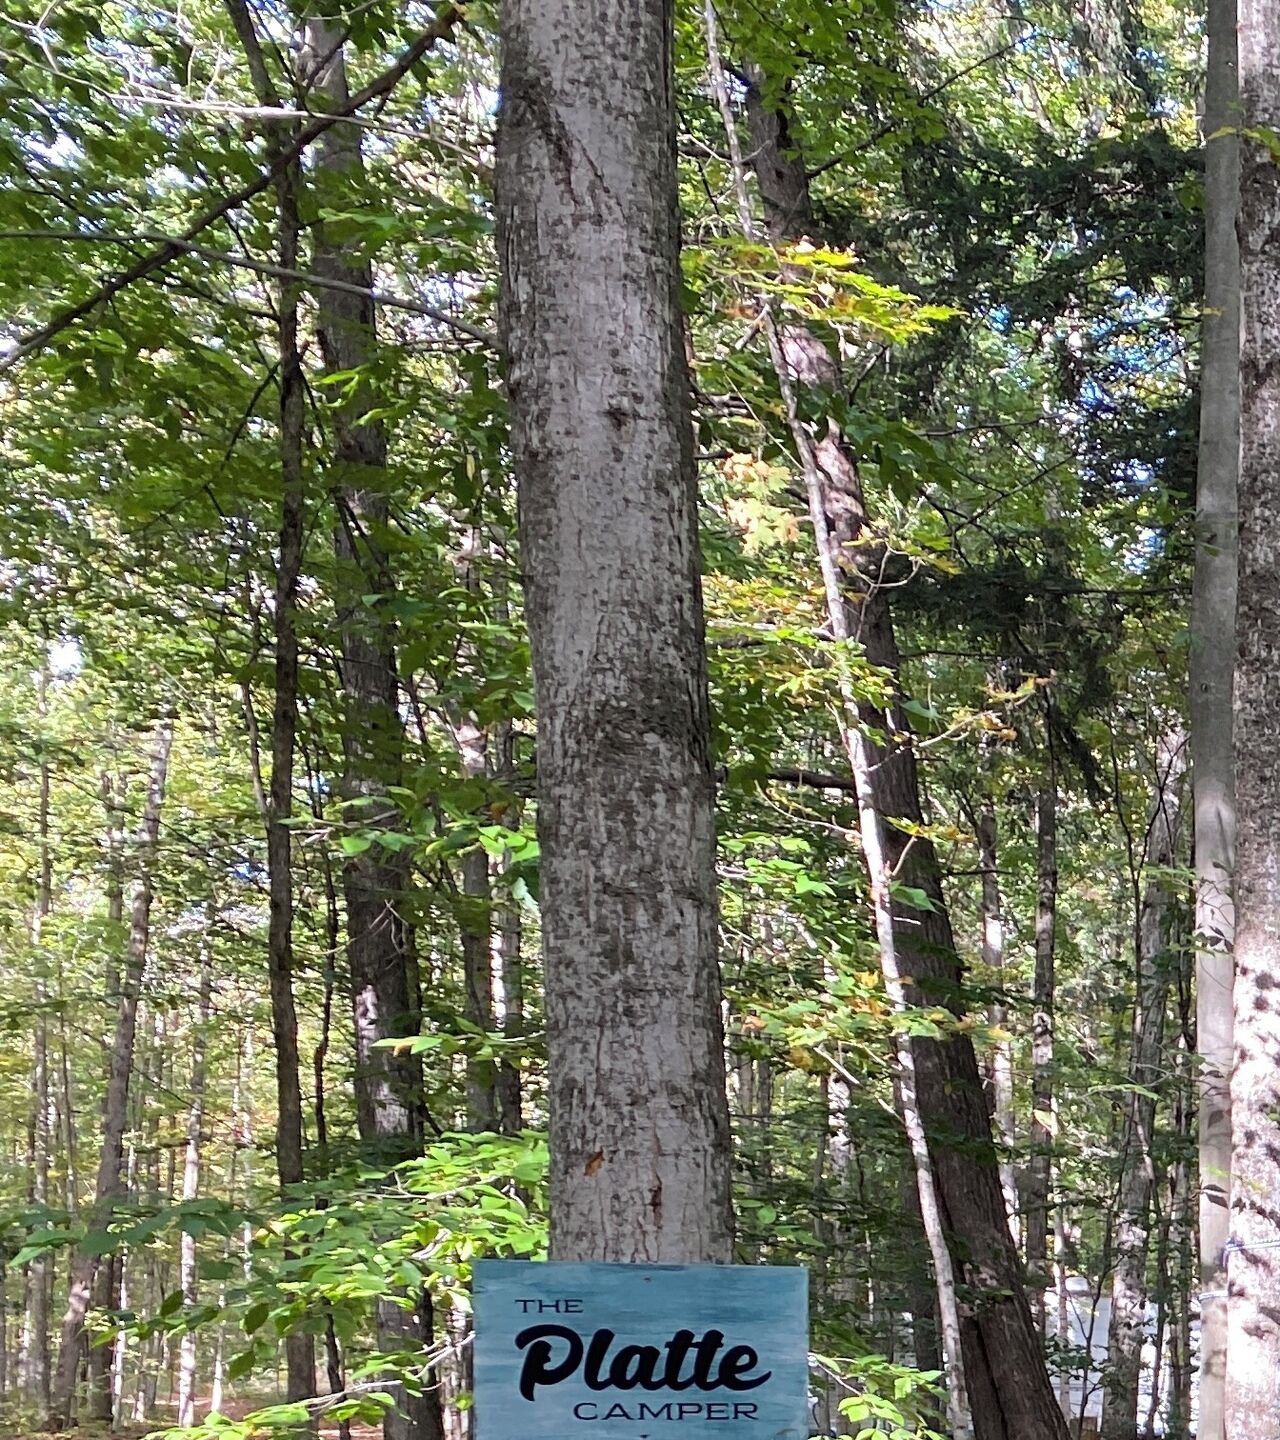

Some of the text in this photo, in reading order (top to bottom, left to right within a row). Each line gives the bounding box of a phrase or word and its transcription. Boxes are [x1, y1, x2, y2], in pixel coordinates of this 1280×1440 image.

[515, 1299, 584, 1313] THE
[515, 1324, 772, 1401] Platte
[573, 1402, 758, 1421] CAMPER
